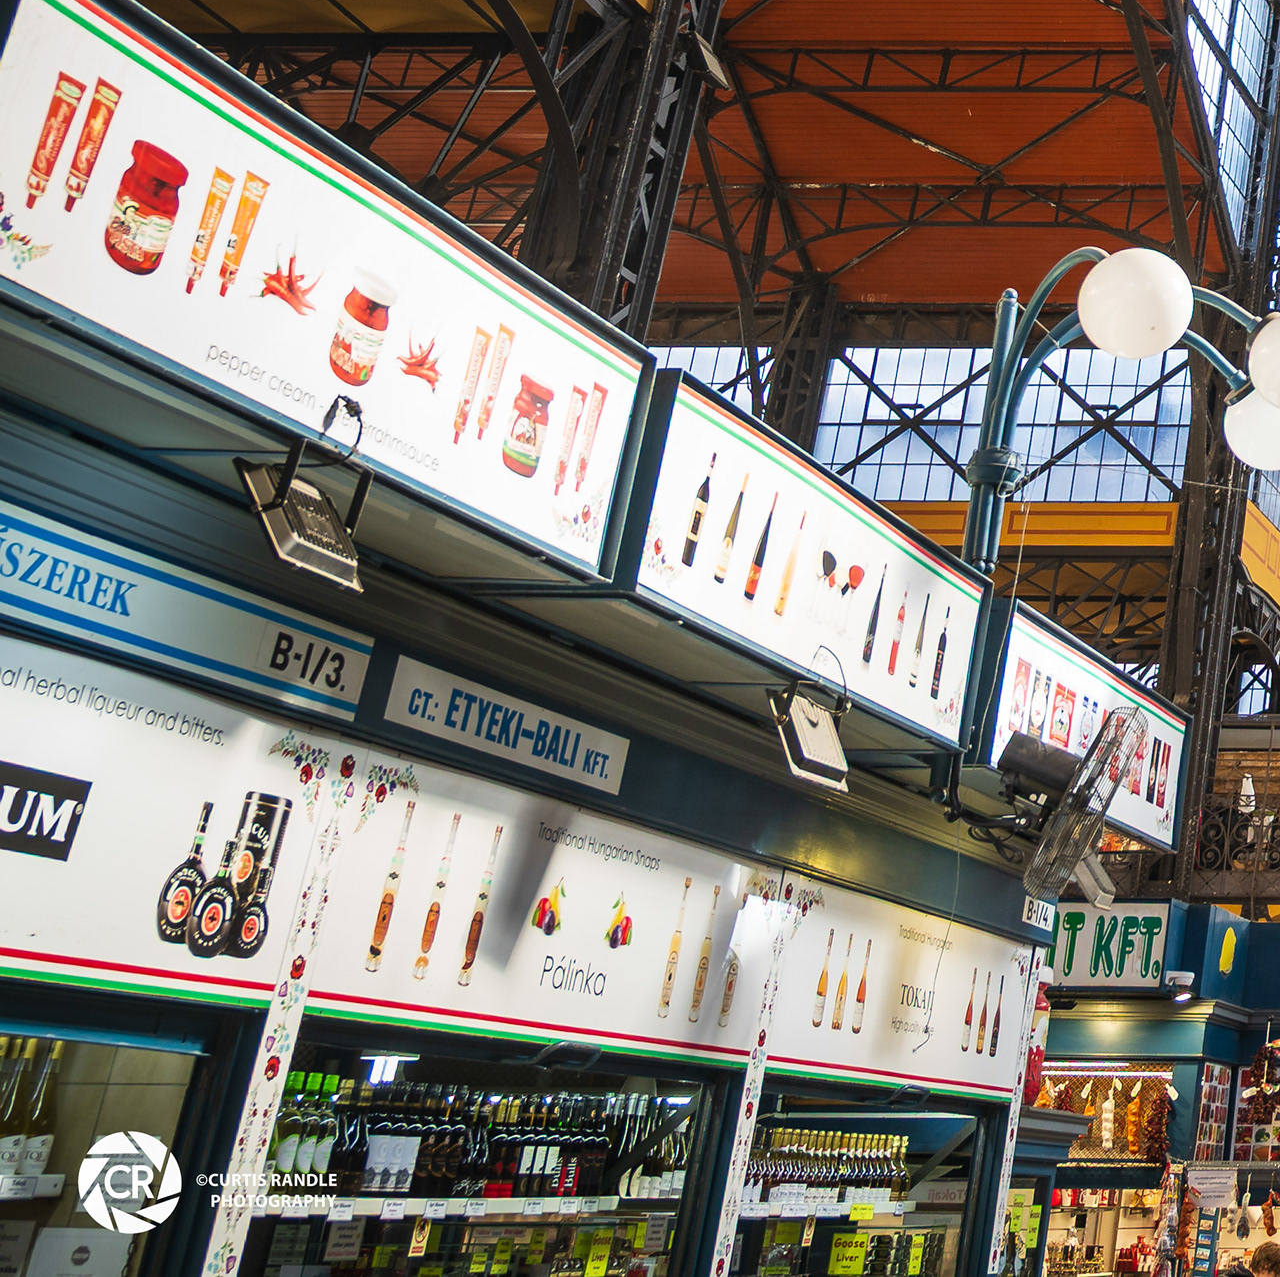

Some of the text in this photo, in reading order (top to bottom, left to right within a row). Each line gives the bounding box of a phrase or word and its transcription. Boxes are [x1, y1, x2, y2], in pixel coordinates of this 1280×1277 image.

[206, 344, 266, 382] pepper
[268, 374, 317, 410] cream
[24, 669, 86, 704] herbal
[86, 686, 144, 721] liqueur
[145, 706, 179, 732] and
[179, 715, 226, 747] bitters.
[582, 748, 610, 779] KFT.
[538, 822, 661, 872] Traditional Hungarian Snaps
[900, 925, 926, 943] Traditional
[1090, 915, 1162, 979] KFT.
[540, 954, 607, 997] Pálinka
[834, 1237, 866, 1250] Goose
[836, 1253, 860, 1263] Liver
